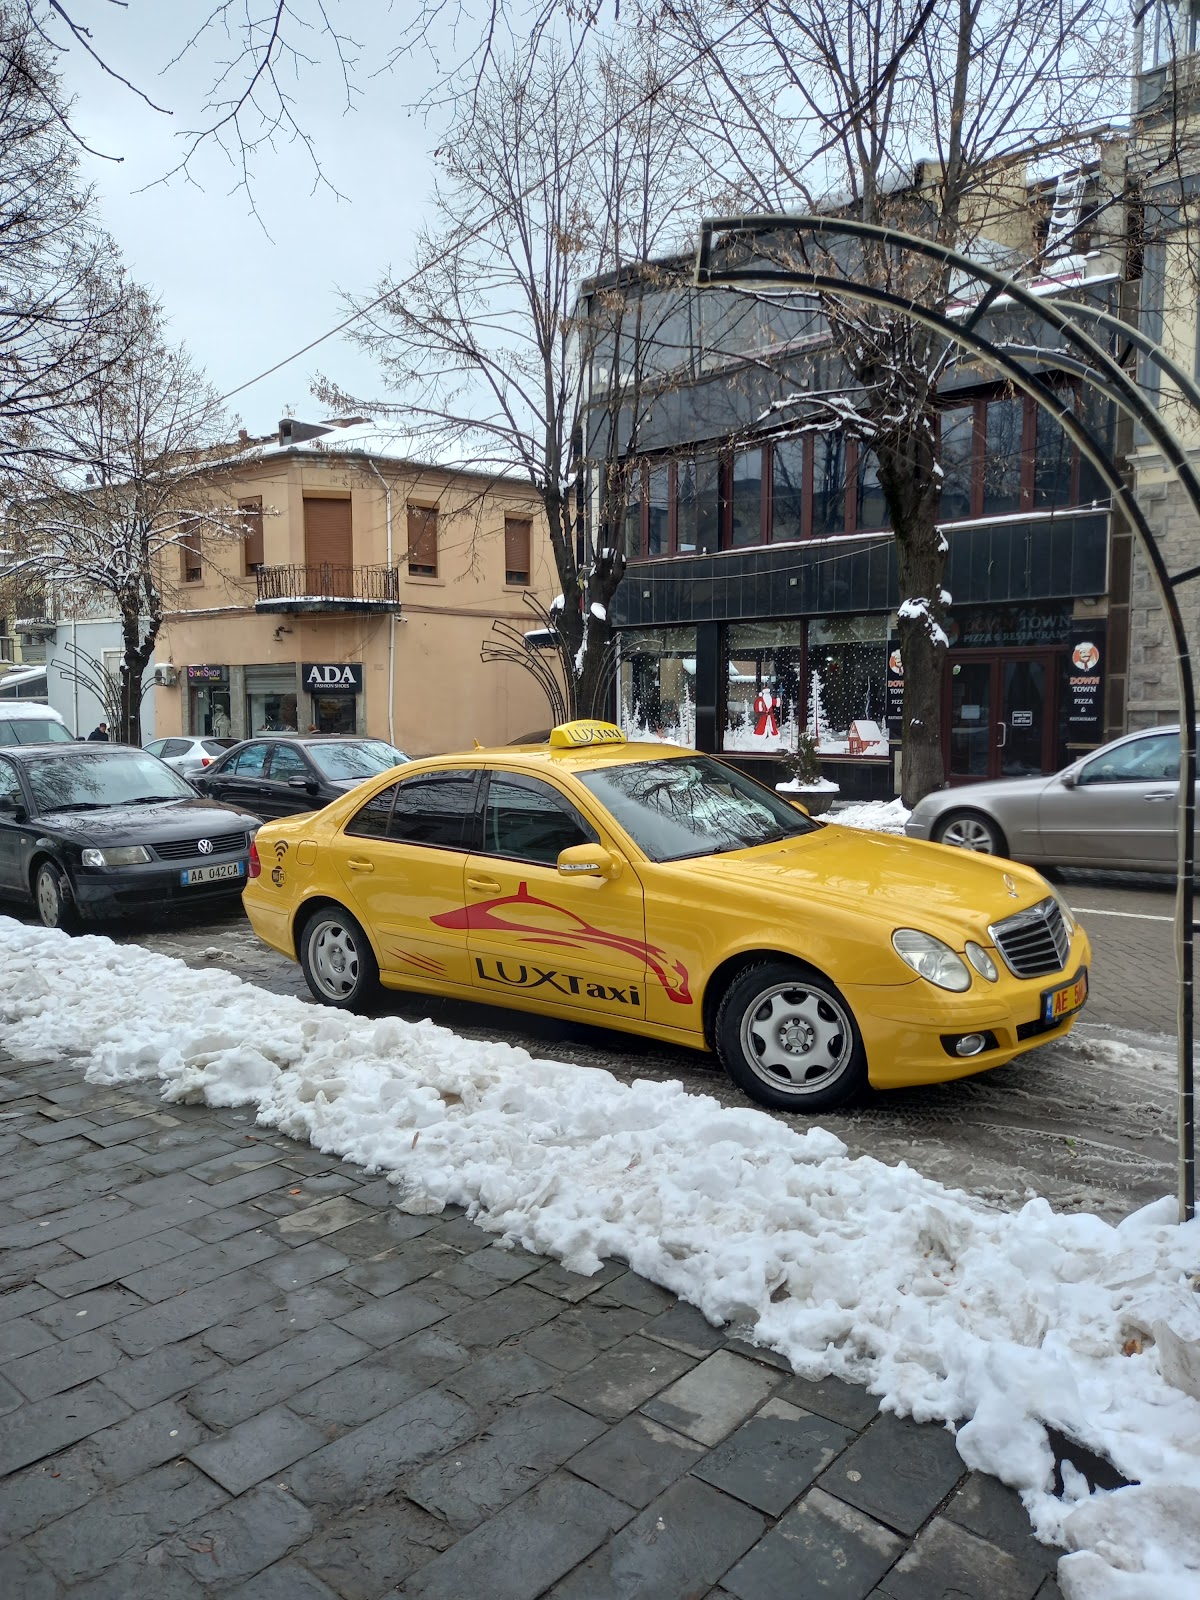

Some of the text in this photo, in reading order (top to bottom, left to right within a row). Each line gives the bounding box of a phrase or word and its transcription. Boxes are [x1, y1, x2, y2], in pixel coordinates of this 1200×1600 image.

[1019, 614, 1072, 630] TOWN
[963, 632, 992, 643] PIZZA
[307, 666, 356, 683] ADA
[1069, 677, 1100, 685] DOWN
[191, 869, 204, 881] AA
[1055, 990, 1068, 1013] AE
